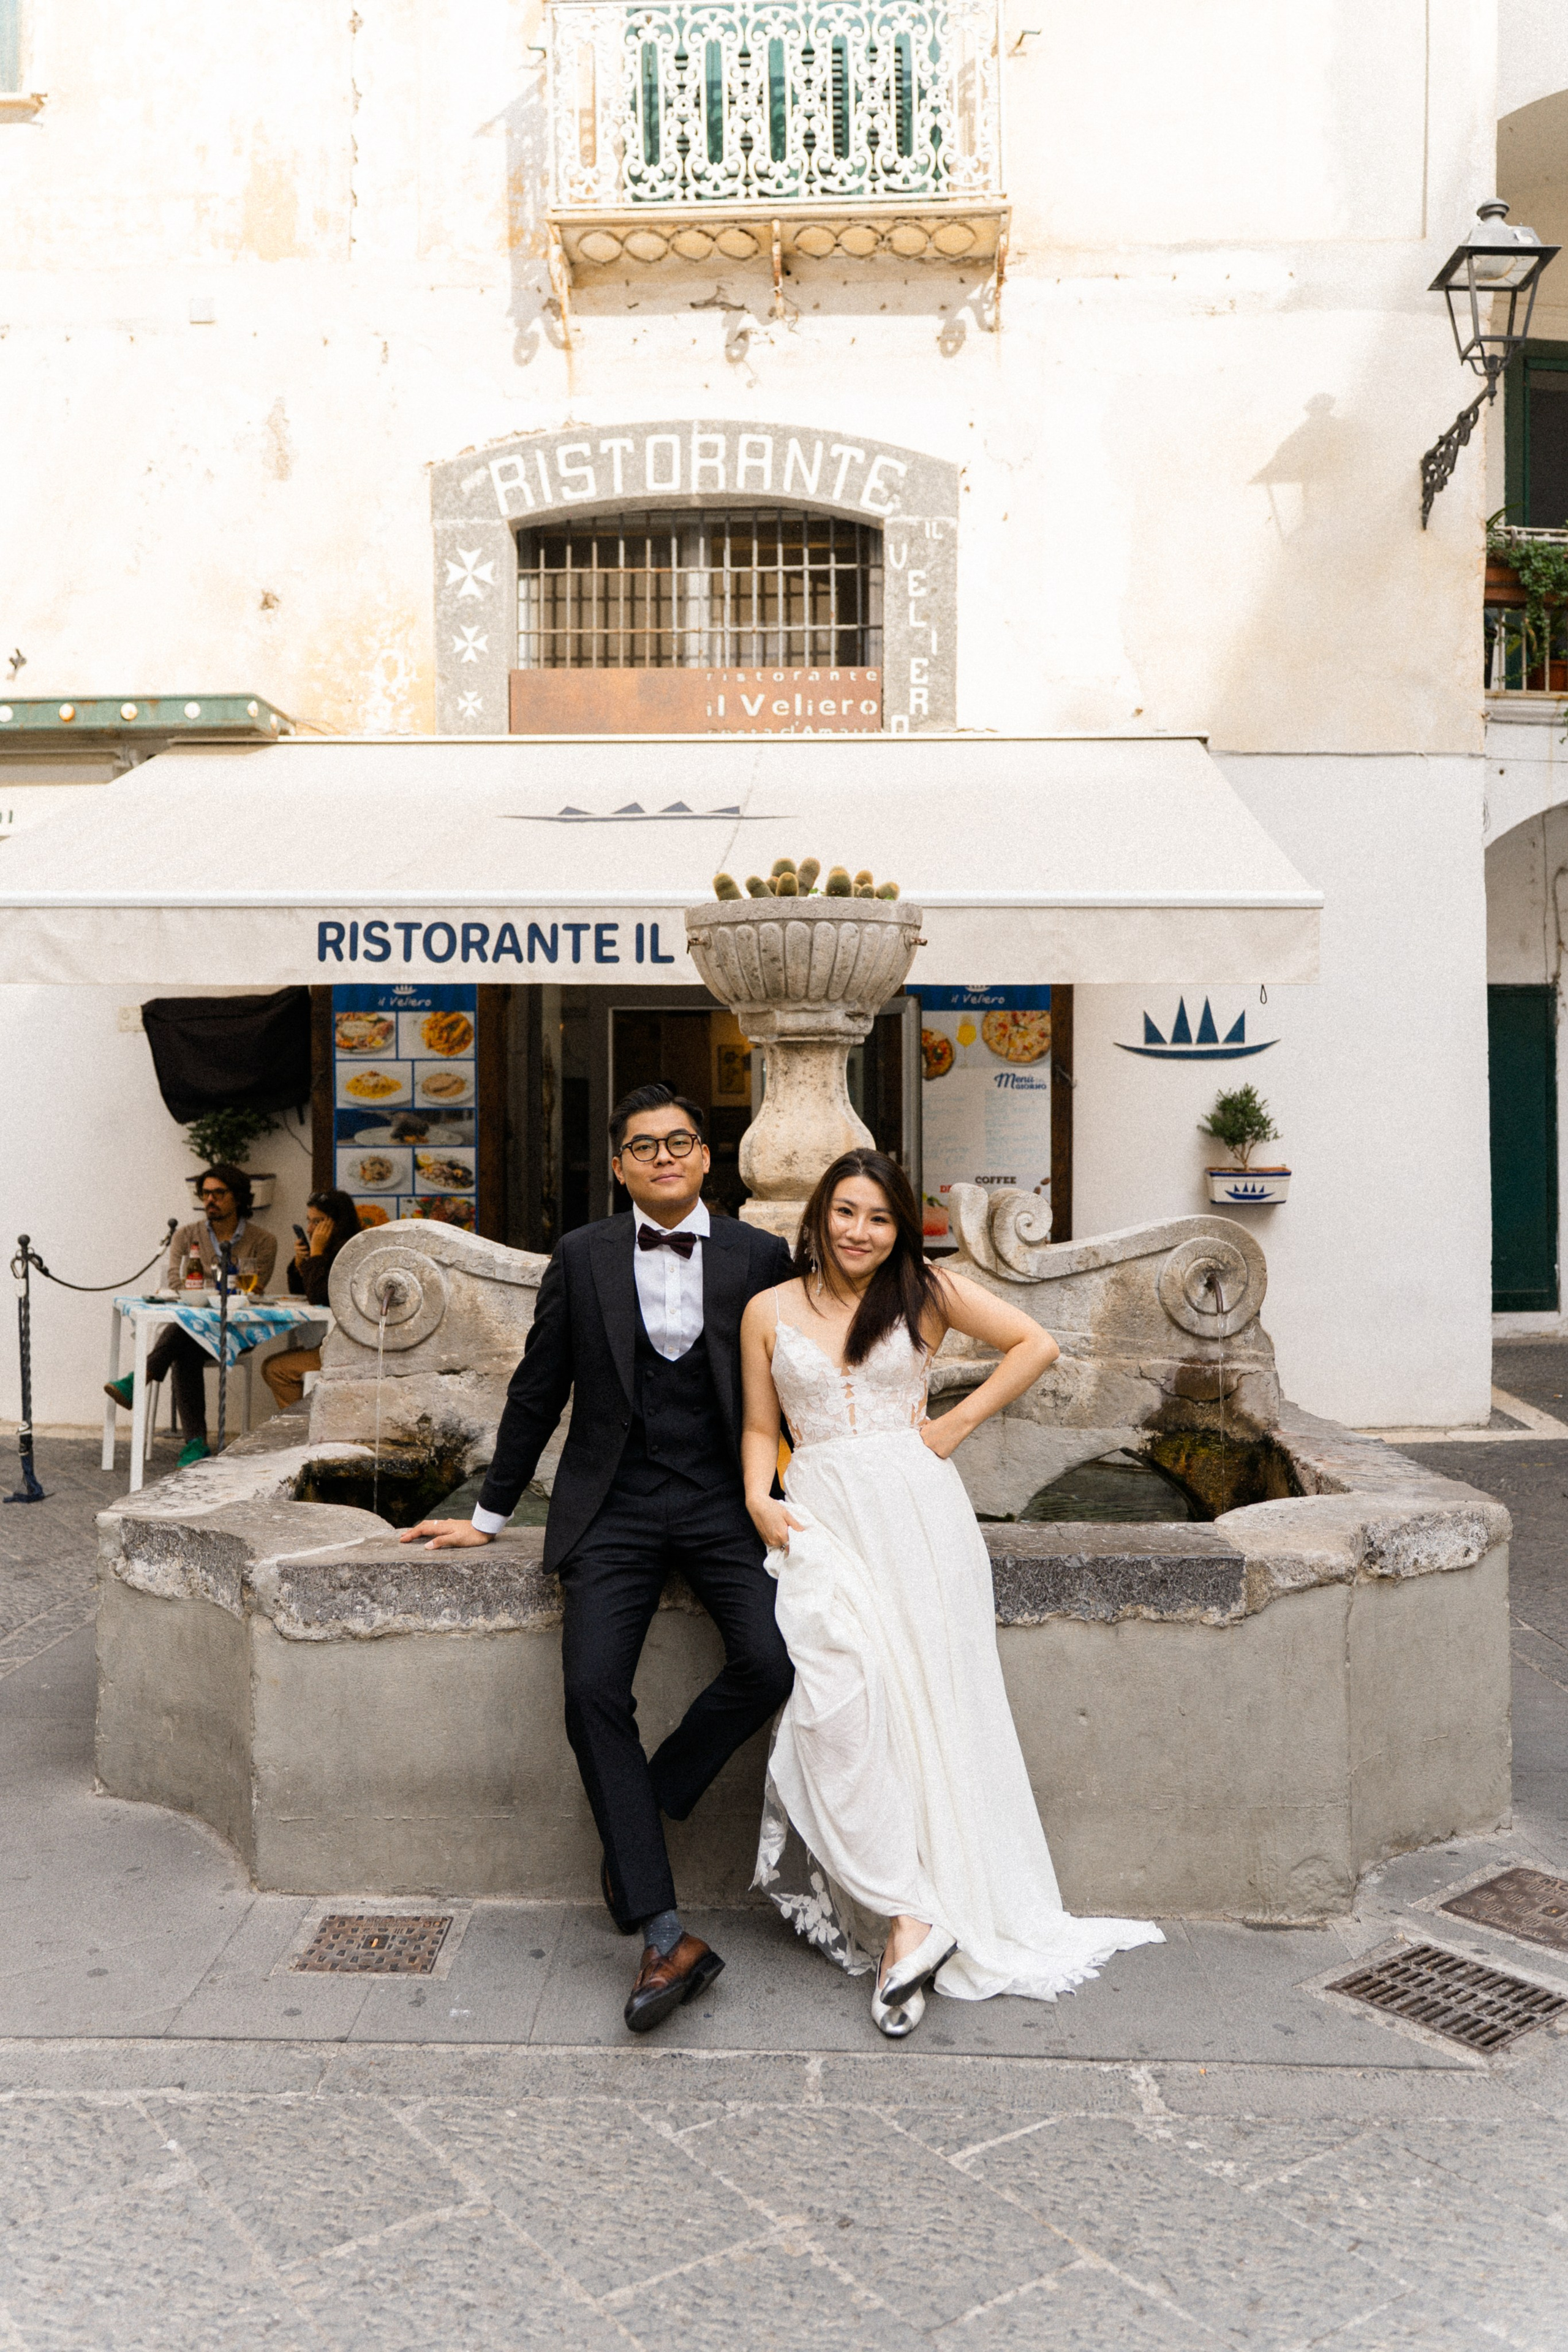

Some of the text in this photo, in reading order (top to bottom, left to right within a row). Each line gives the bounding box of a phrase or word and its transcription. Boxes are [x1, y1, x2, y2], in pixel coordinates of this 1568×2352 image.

[488, 432, 907, 516] RISTORANTE
[925, 521, 943, 539] IL
[706, 670, 878, 682] ristorante
[706, 693, 878, 717] il Veliero
[317, 920, 674, 963] RISTORANTE IL
